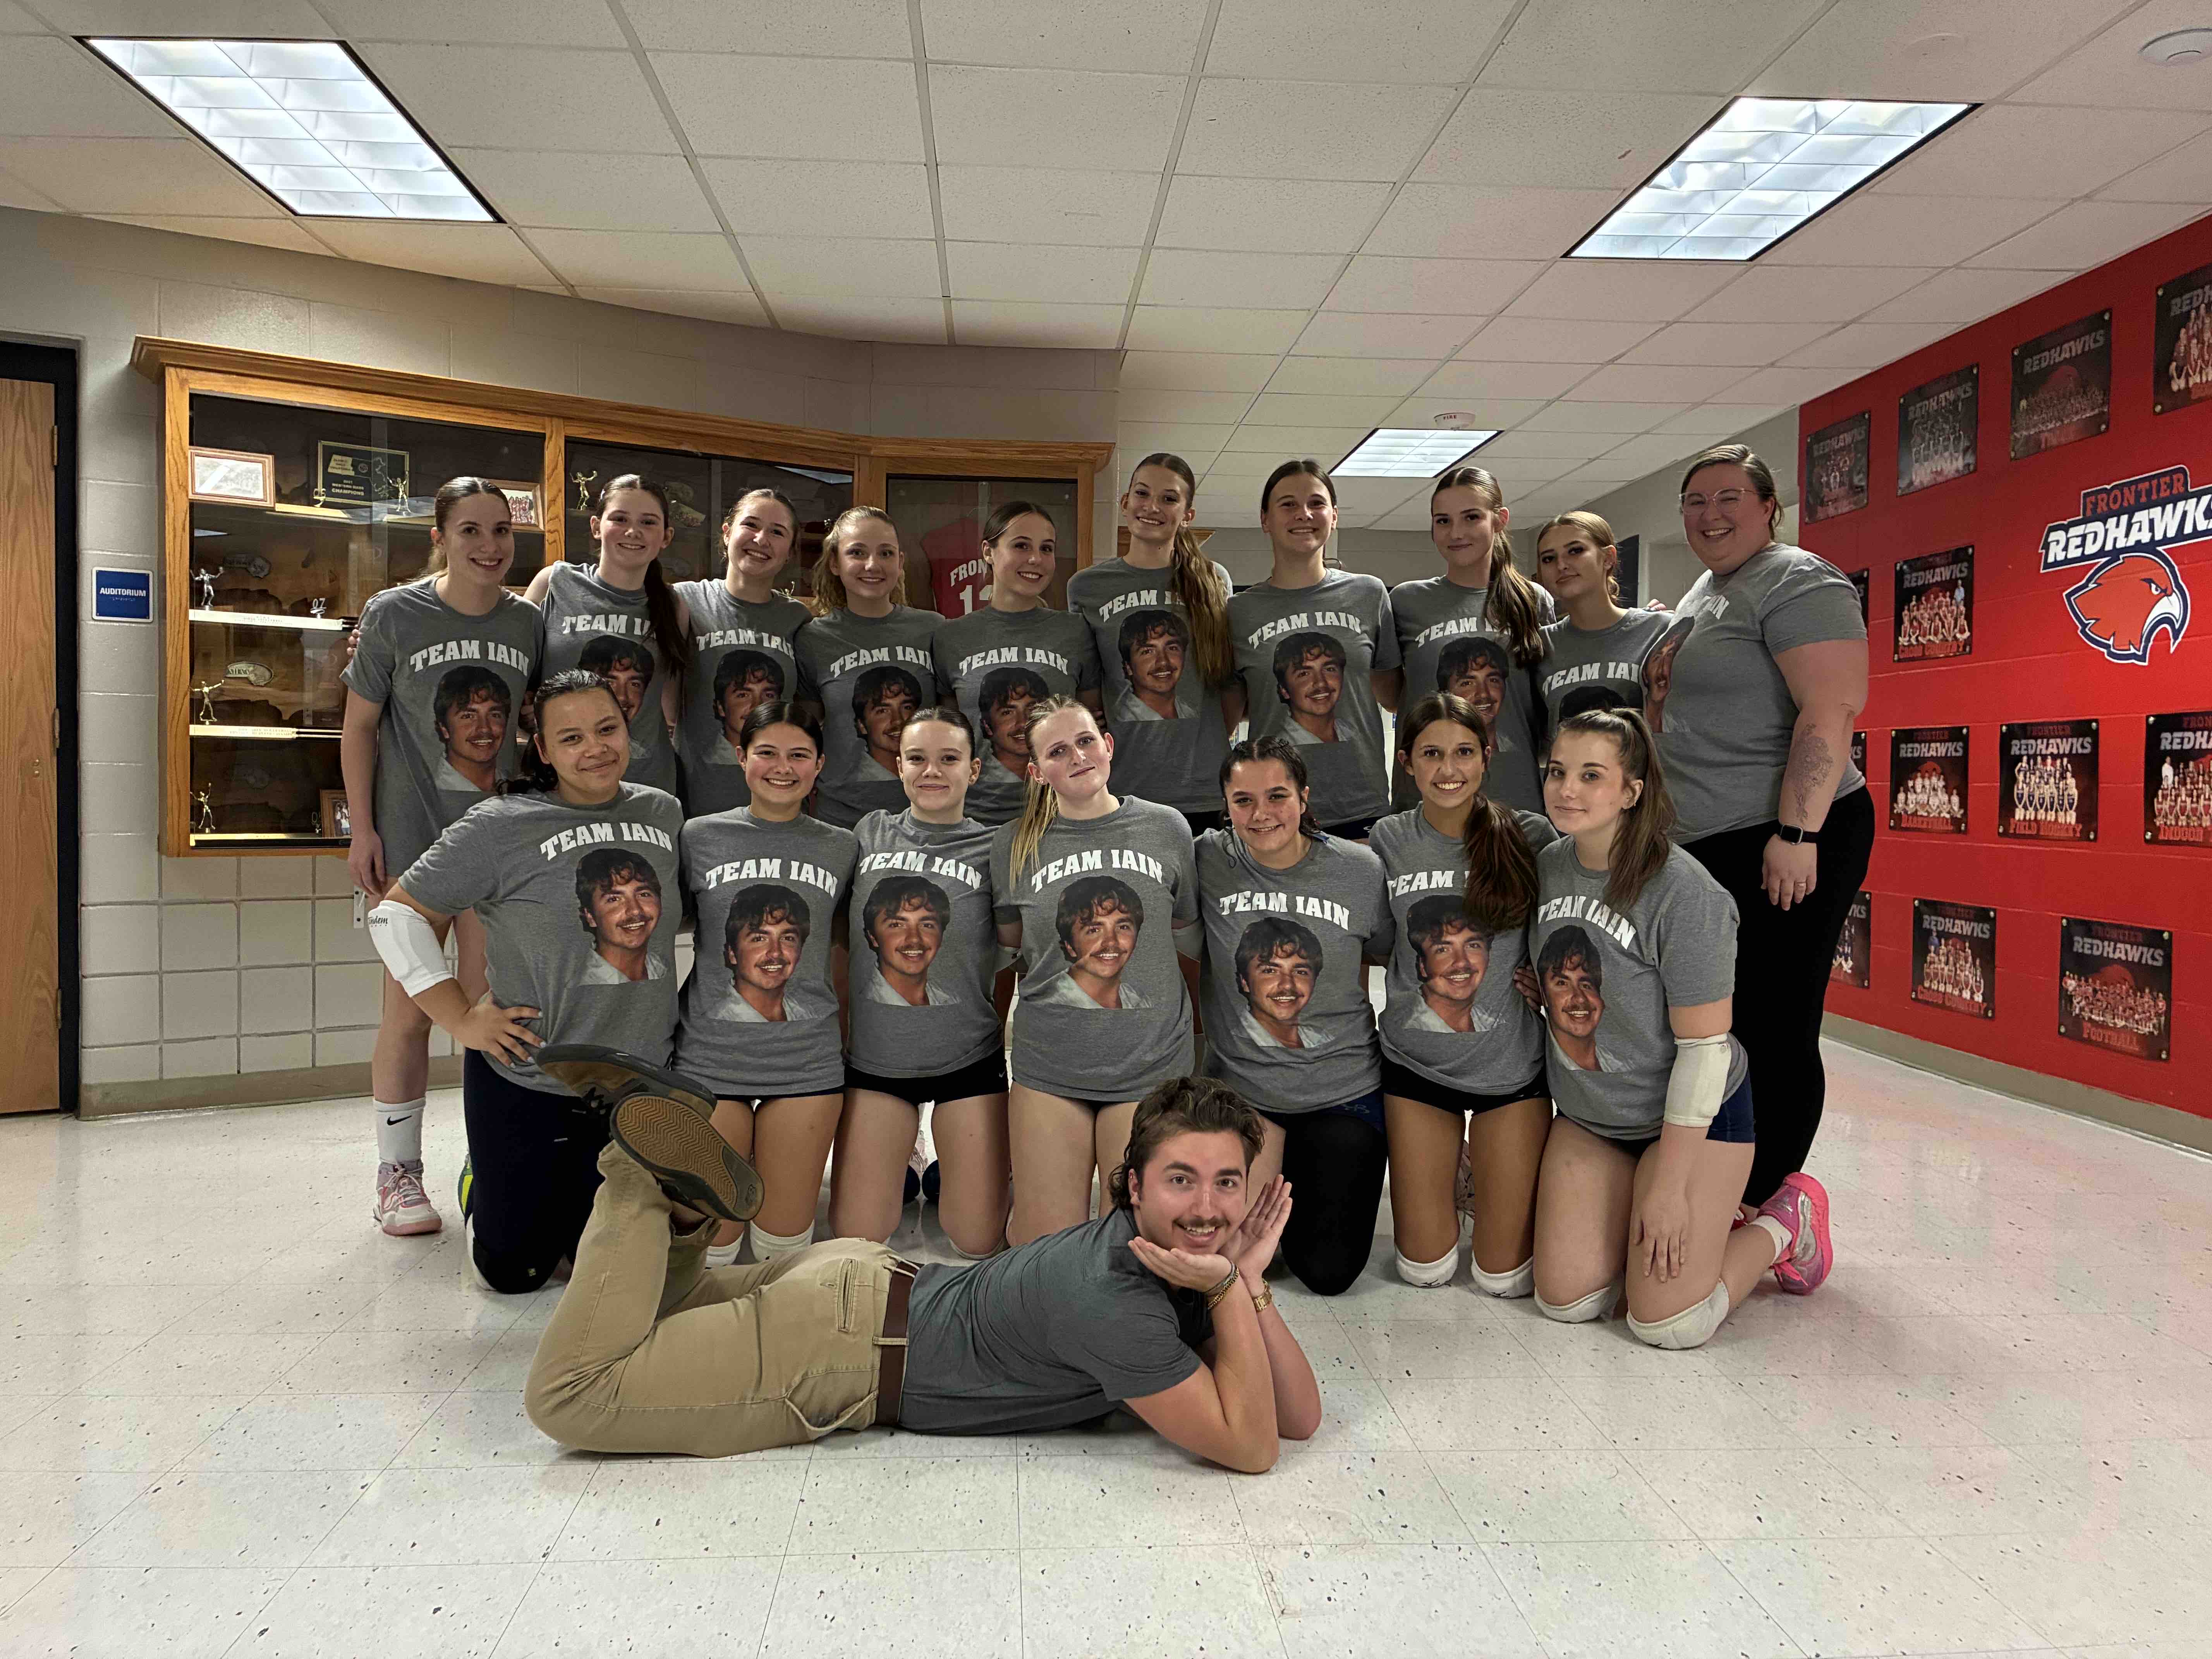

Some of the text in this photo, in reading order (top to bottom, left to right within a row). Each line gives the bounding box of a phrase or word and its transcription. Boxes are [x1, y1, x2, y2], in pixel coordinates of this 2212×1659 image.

[2170, 283, 2212, 316] REDH
[2023, 330, 2105, 374] REDHAWKS
[2086, 473, 2185, 517] FRONTIER
[2047, 494, 2212, 563] REDHAWK
[950, 558, 988, 587] FRON
[1903, 562, 1968, 588] REDHAWKS
[100, 587, 146, 596] AUDITORIUM
[313, 598, 326, 608] 07
[1099, 589, 1157, 623] TEAM
[562, 614, 627, 634] TEAM
[697, 628, 758, 651] TEAM
[1248, 611, 1362, 649] TEAM IAIN
[1415, 617, 1478, 648] TEAM
[410, 640, 529, 676] TEAM IAIN
[830, 647, 890, 678] TEAM
[959, 646, 1068, 676] TEAM IAIN
[1542, 662, 1639, 697] TEAM IAI
[1899, 742, 1963, 757] REDHAWKS
[2011, 737, 2092, 755] REDHAWKS
[2160, 731, 2212, 750] REDH
[541, 823, 672, 861] TEAM IAIN
[706, 858, 838, 898] TEAM IAIN
[859, 851, 982, 890] TEAM IAIN
[1031, 849, 1163, 893] TEAM IAIN
[1387, 871, 1455, 901] TEAM
[1219, 892, 1350, 931] TEAM IAIN
[1538, 895, 1637, 950] TEAM IAIN
[1923, 915, 1990, 939] REDHAWKS
[2073, 936, 2164, 967] REDHAWKS
